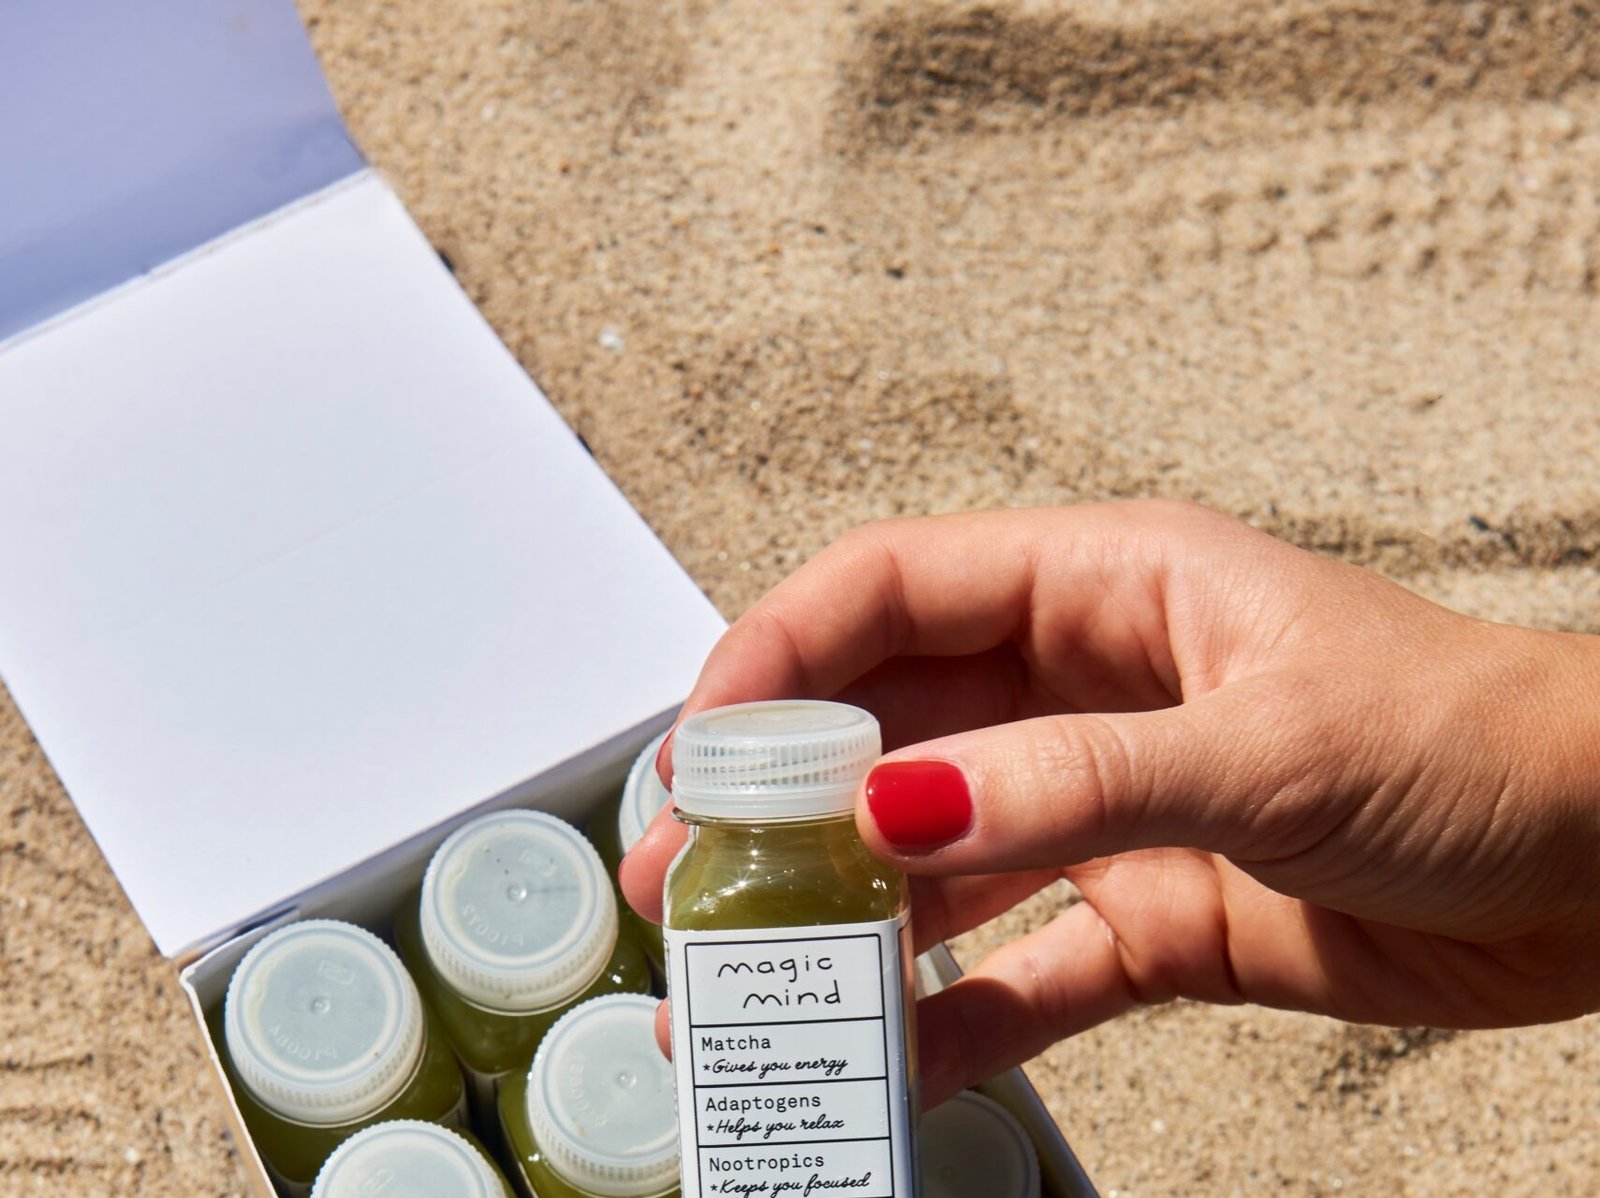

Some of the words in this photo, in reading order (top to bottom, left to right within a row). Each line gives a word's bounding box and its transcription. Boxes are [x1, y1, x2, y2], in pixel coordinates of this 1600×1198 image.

[718, 955, 833, 982] magic
[743, 978, 841, 1009] mind
[702, 1035, 771, 1051] Matcha
[759, 1062, 791, 1079] you
[795, 1058, 848, 1076] energy
[706, 1096, 821, 1114] Adaptogens
[764, 1122, 796, 1139] you
[800, 1113, 844, 1130] relax
[709, 1154, 824, 1172] Nootropics
[770, 1182, 803, 1198] you
[804, 1172, 871, 1198] focused
